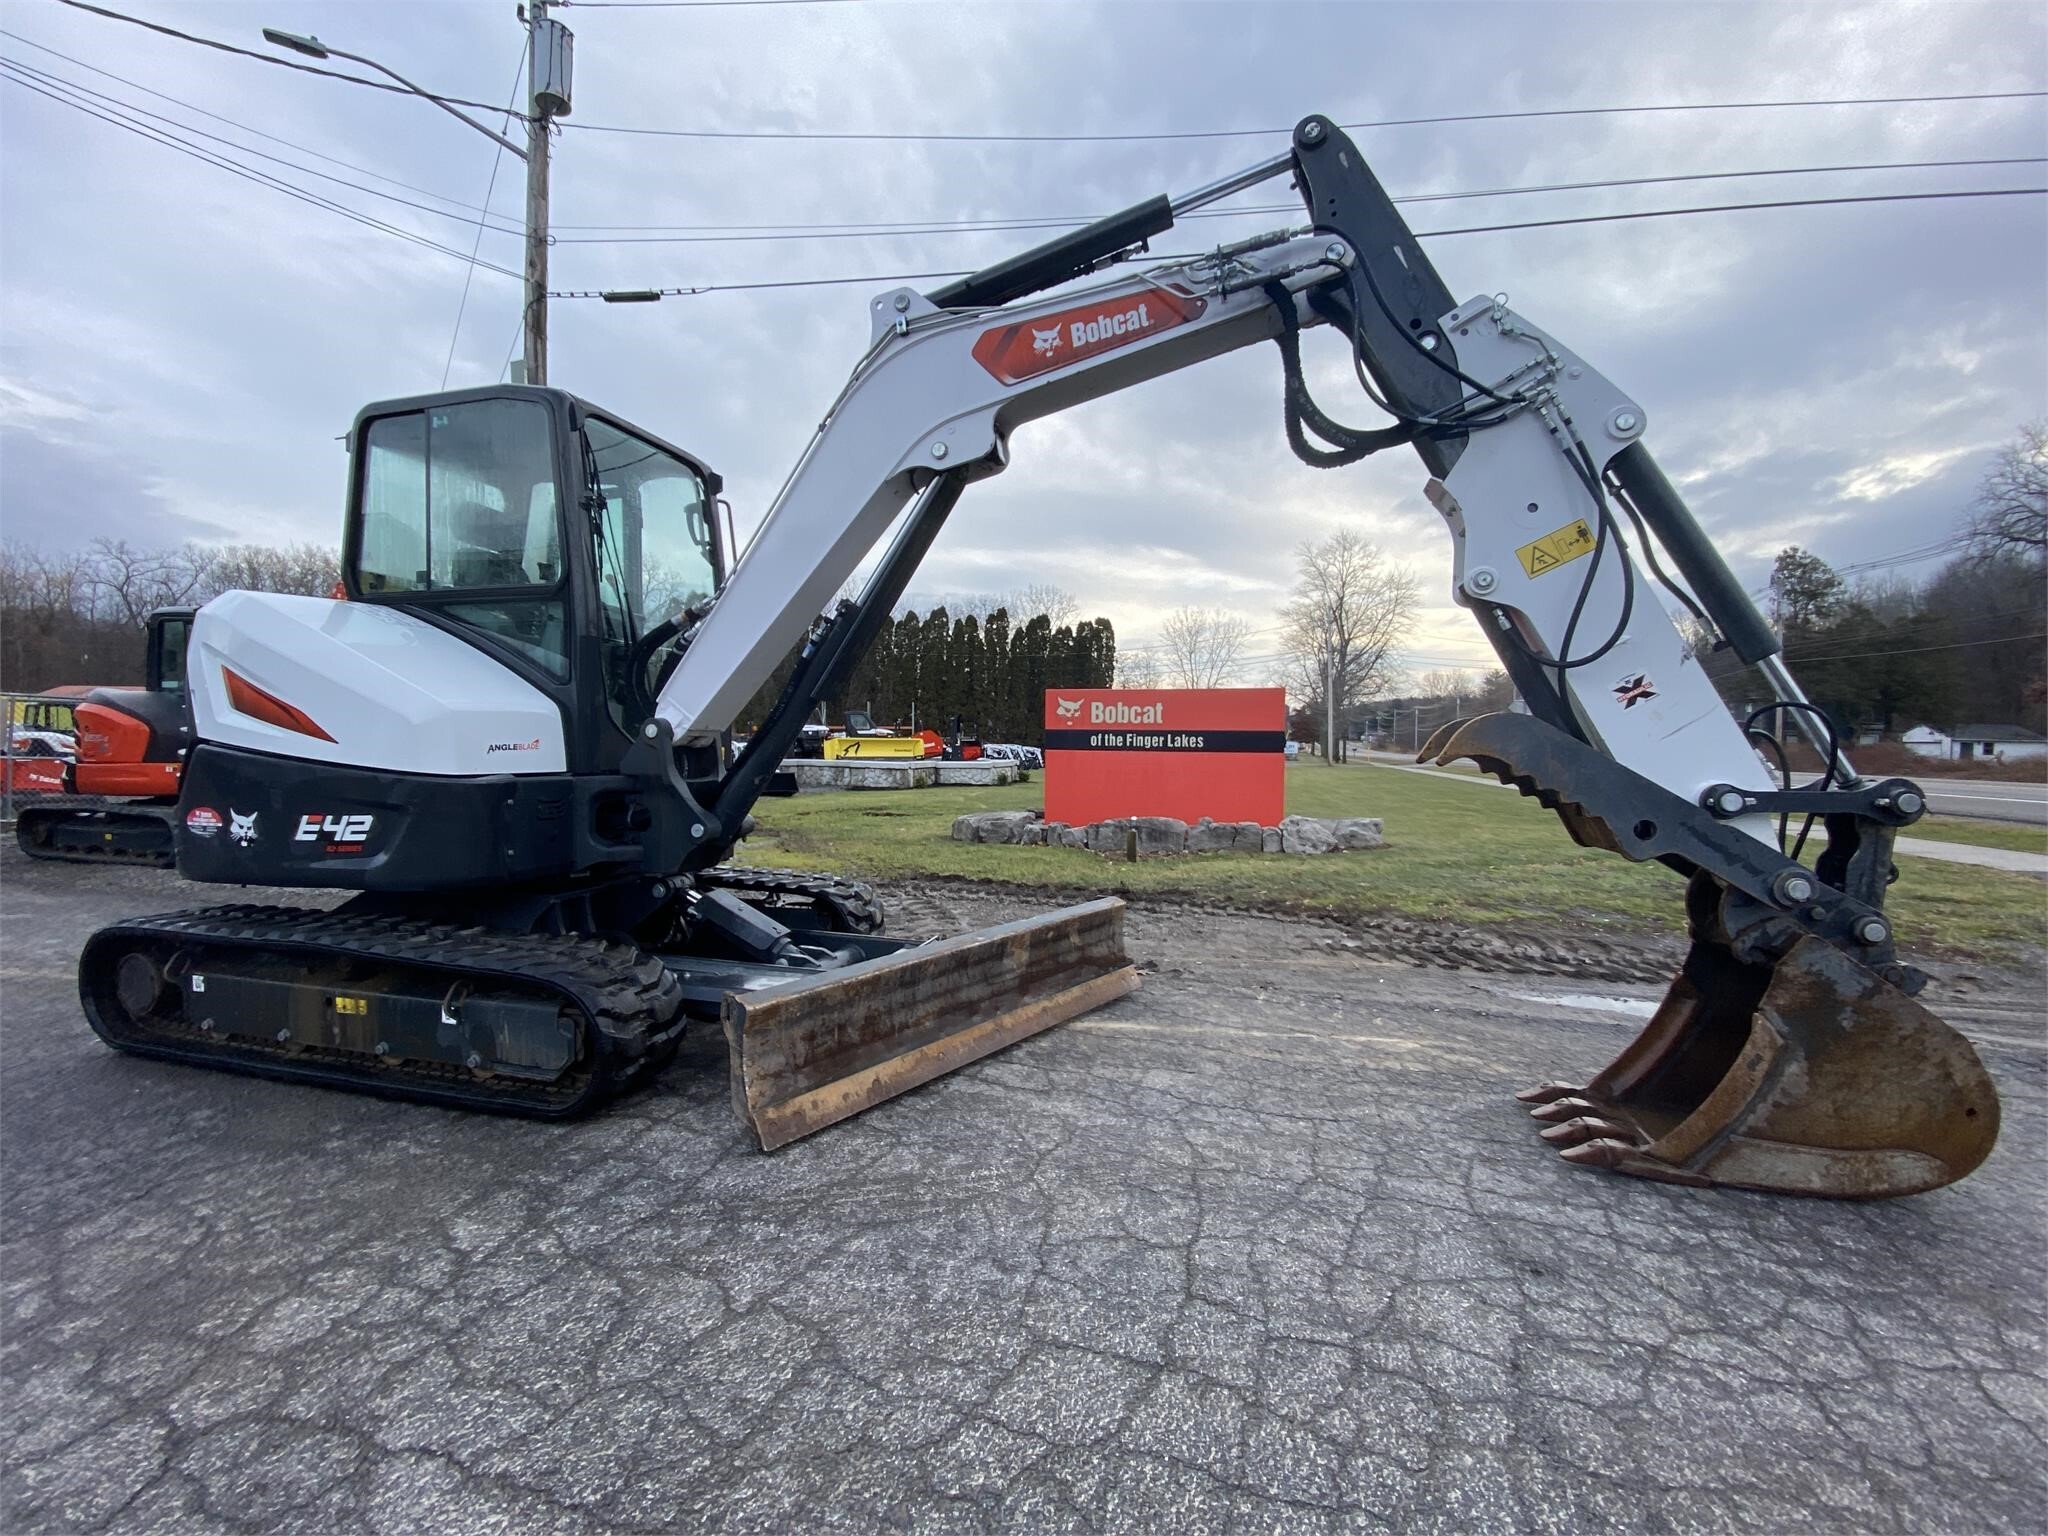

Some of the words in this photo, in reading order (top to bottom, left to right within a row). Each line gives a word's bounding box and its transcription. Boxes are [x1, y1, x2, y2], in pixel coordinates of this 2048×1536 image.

[1070, 303, 1150, 348] Bobcat
[1091, 701, 1163, 724] Bobcat
[1090, 733, 1102, 746] of
[1104, 733, 1123, 746] the
[1126, 733, 1165, 749] Finger
[1167, 734, 1204, 748] Lakes
[294, 814, 374, 841] E42
